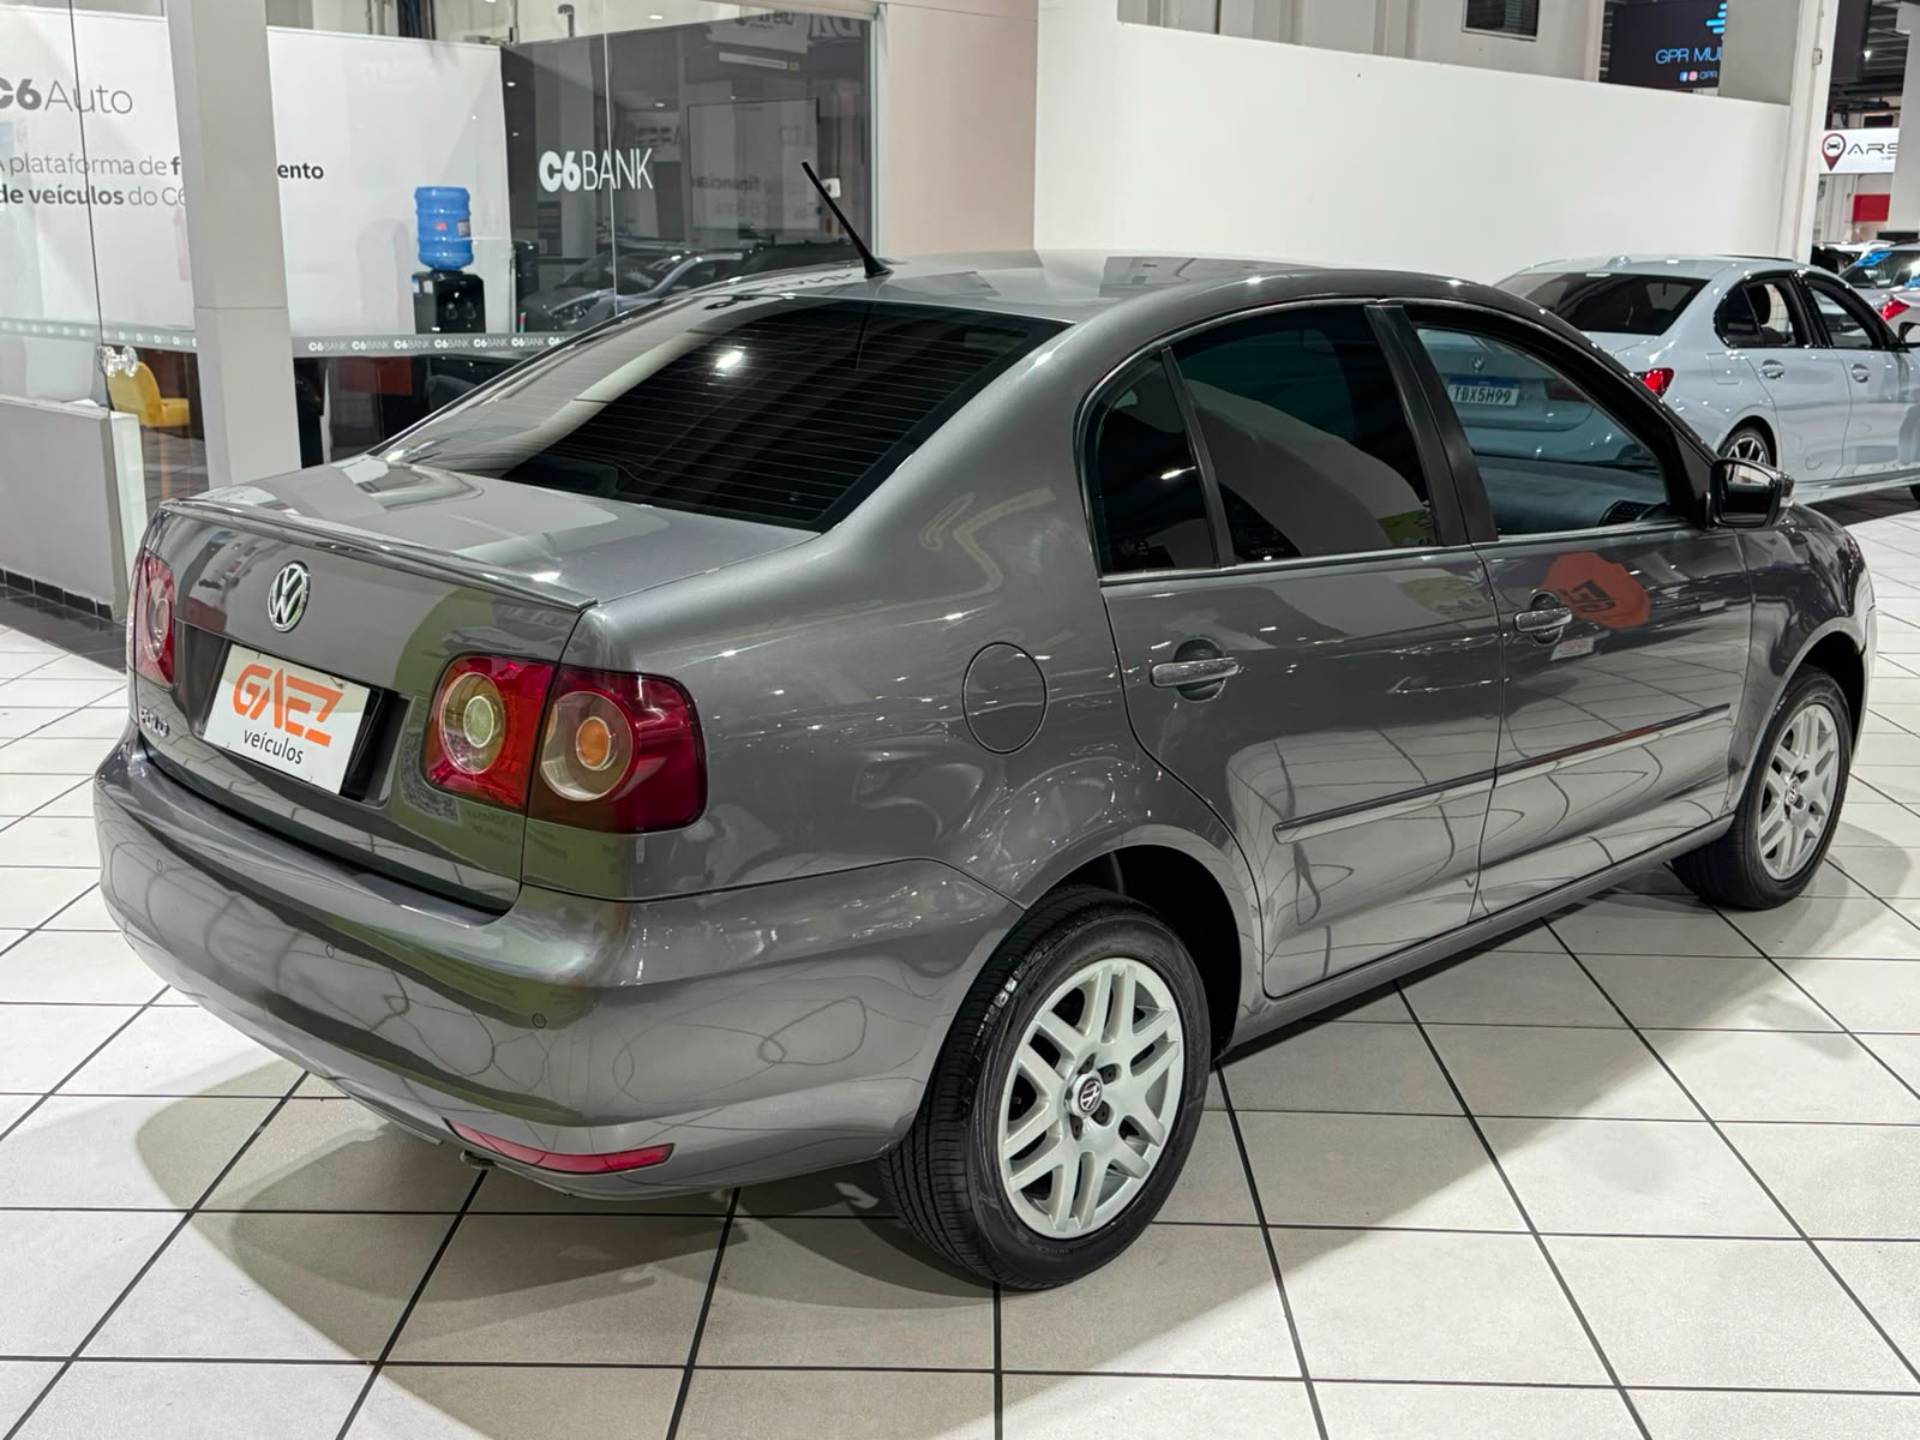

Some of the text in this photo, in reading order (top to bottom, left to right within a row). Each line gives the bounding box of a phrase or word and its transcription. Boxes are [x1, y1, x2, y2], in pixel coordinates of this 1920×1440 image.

[1656, 48, 1689, 64] GPR
[9, 153, 135, 176] plataforma
[139, 155, 167, 176] de
[538, 148, 654, 193] C6BANK
[29, 184, 124, 205] veículos
[129, 186, 158, 206] do
